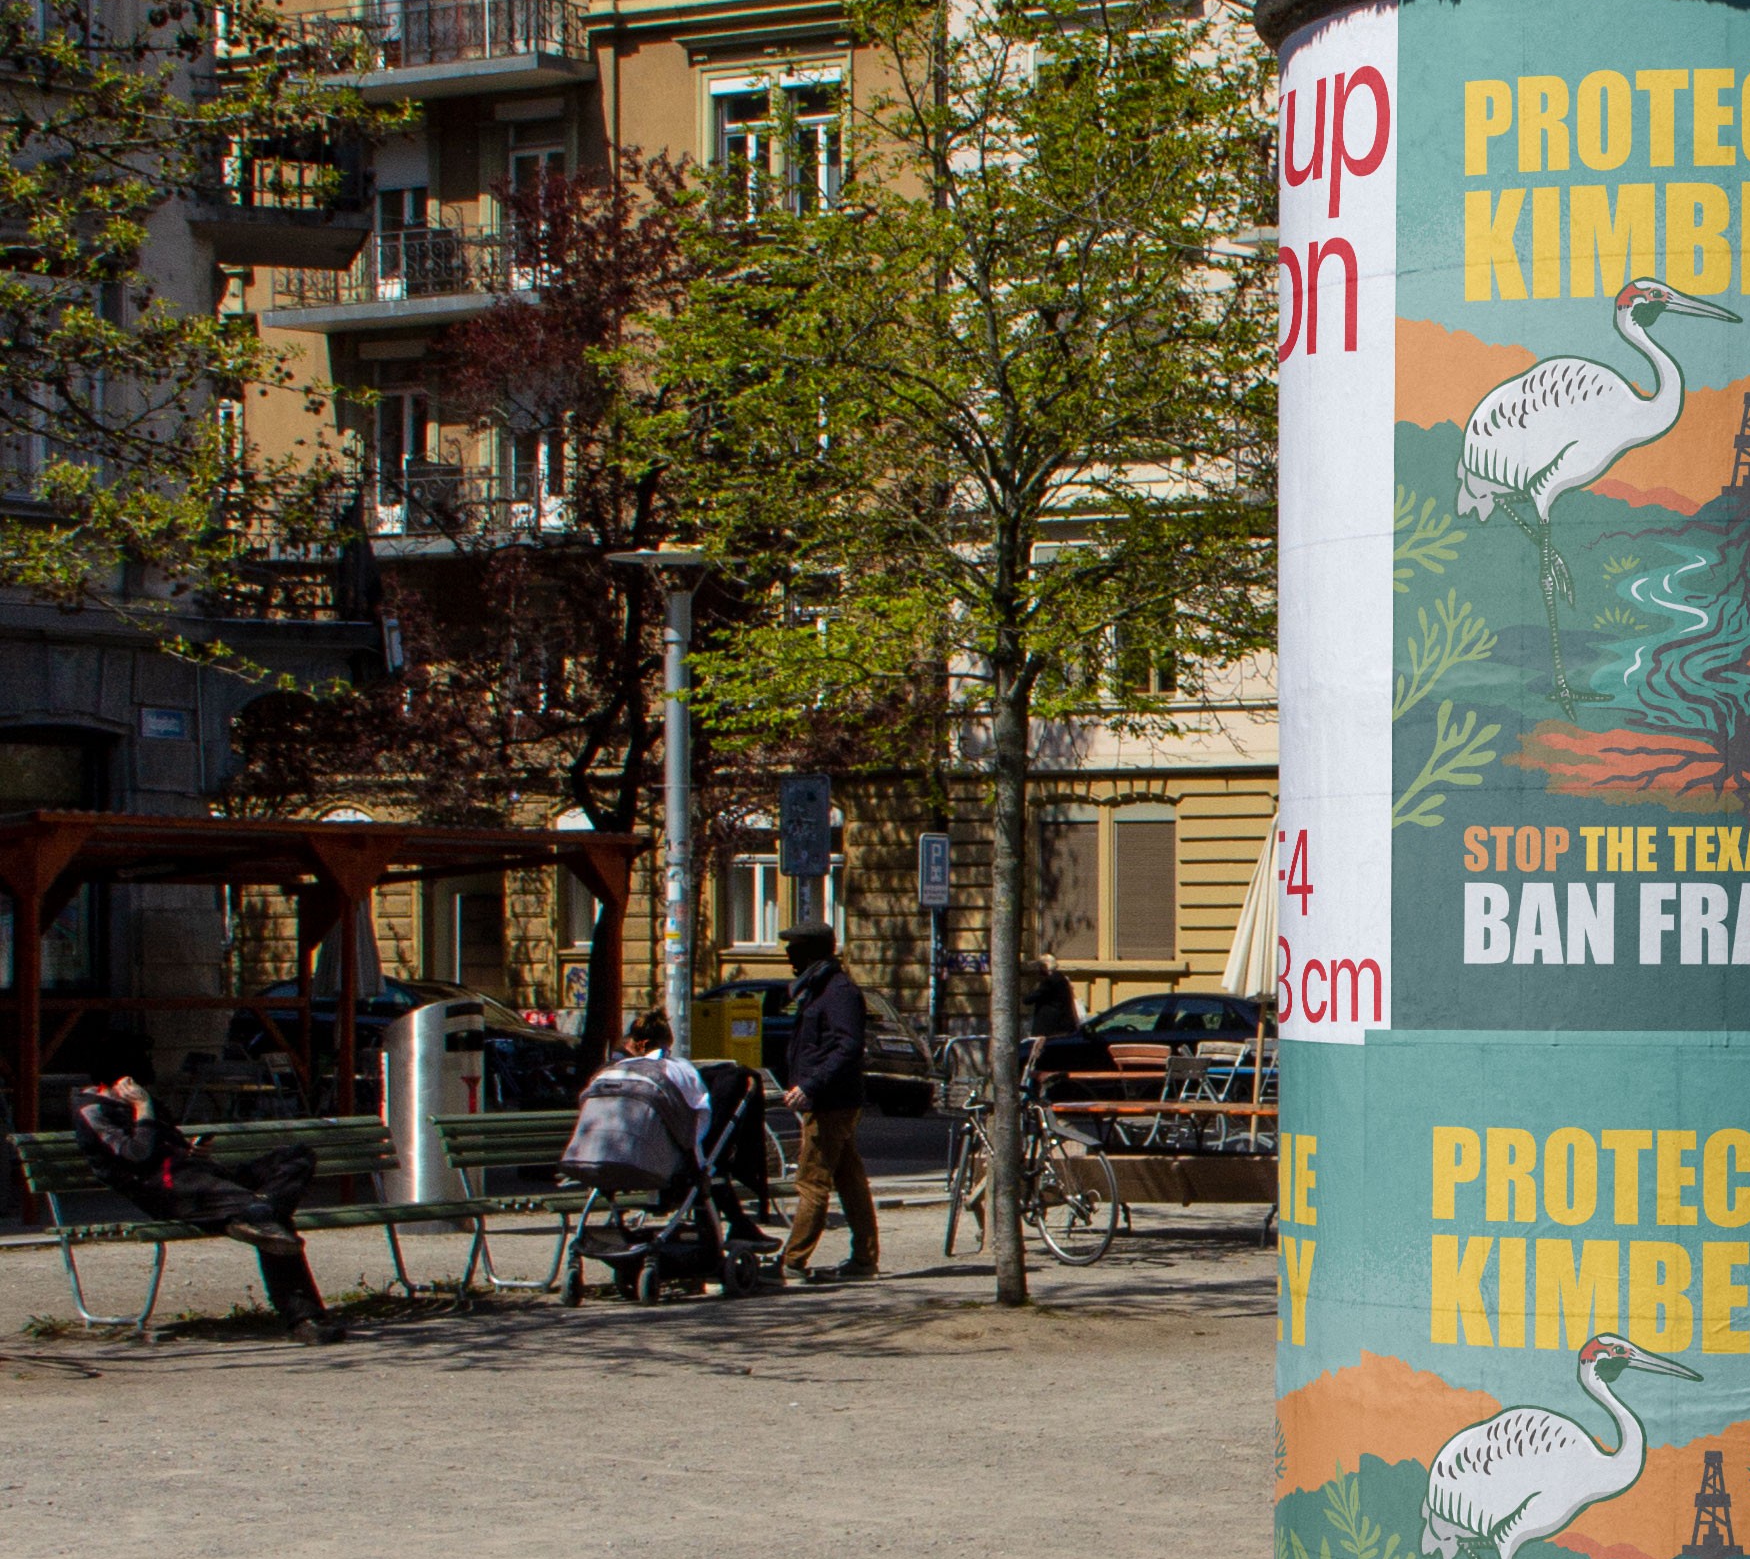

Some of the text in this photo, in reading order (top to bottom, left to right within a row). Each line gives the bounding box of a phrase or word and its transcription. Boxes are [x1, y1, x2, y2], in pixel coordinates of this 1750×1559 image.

[1279, 65, 1391, 219] up
[1464, 826, 1569, 872] STOP
[1580, 826, 1657, 872] THE
[1463, 882, 1615, 966] BAN
